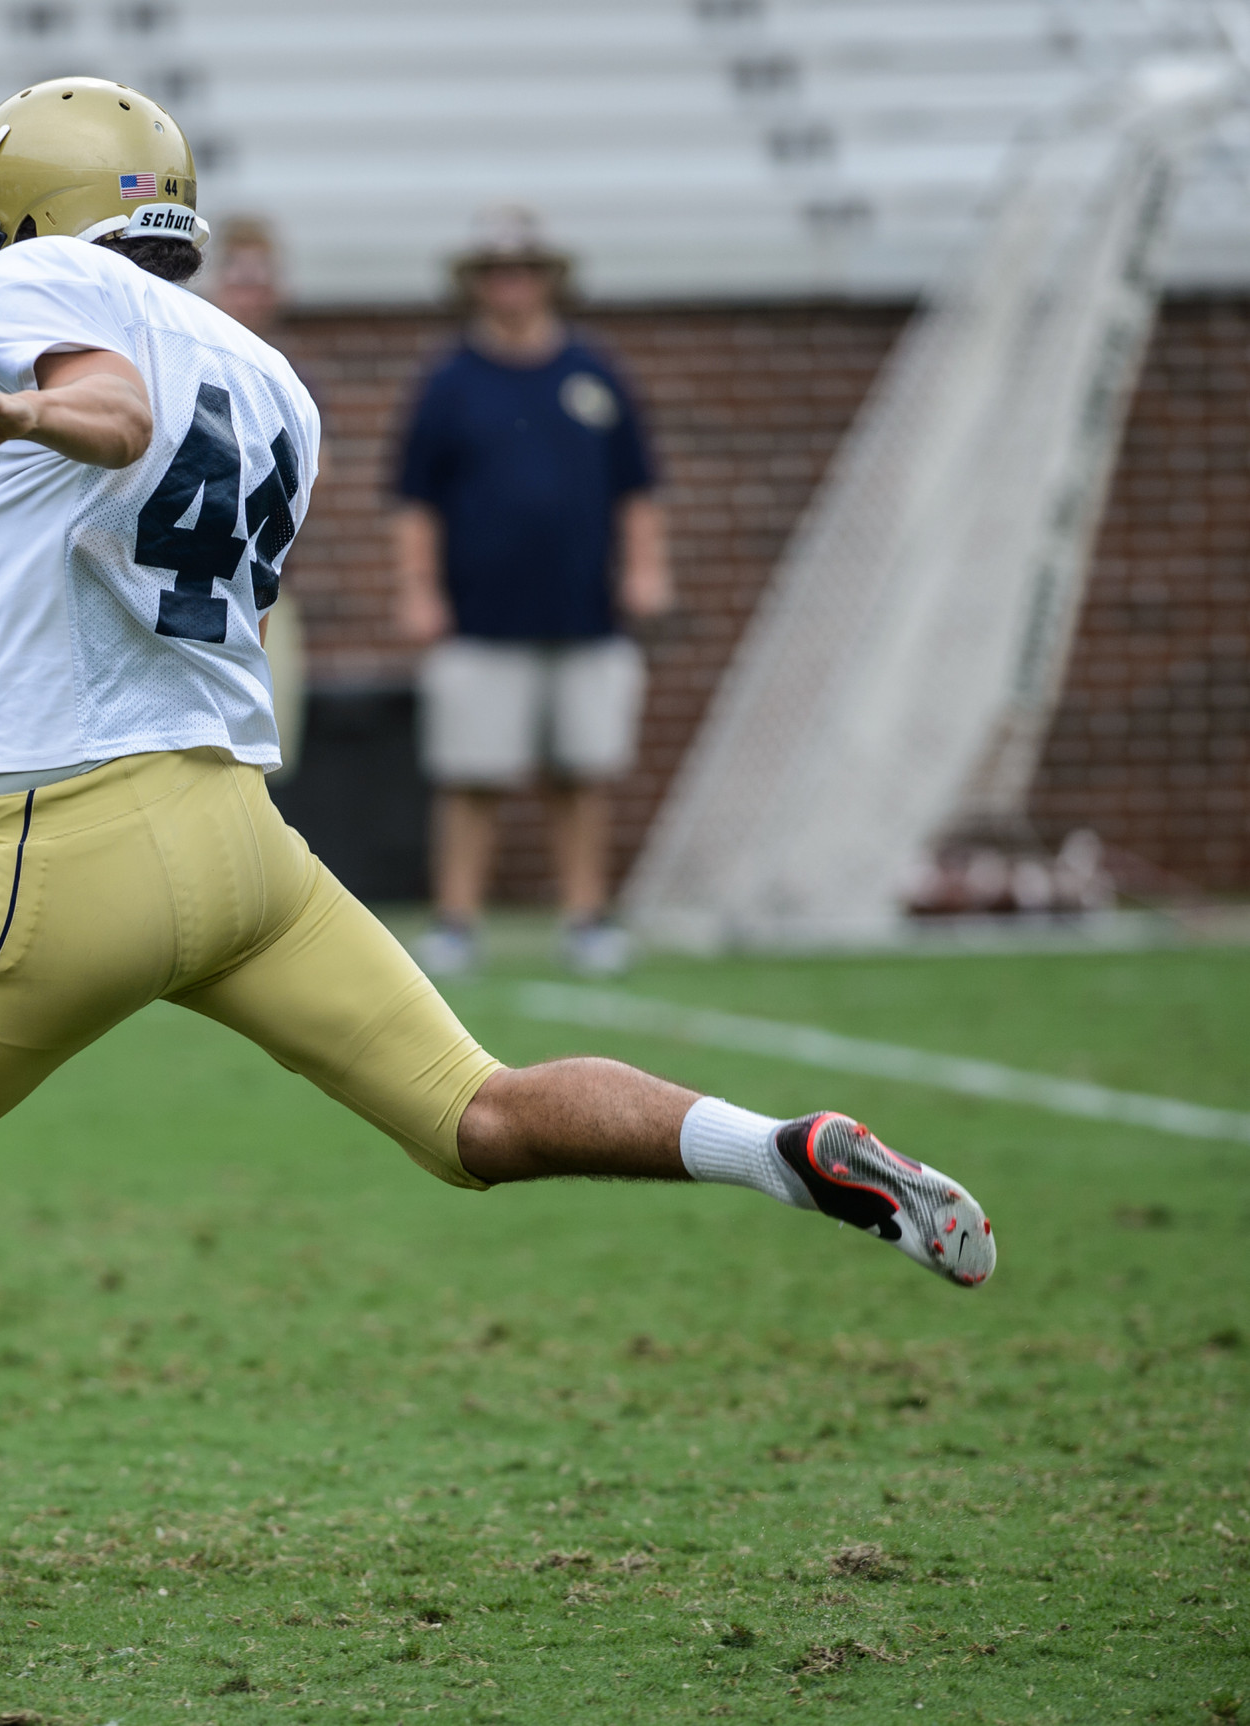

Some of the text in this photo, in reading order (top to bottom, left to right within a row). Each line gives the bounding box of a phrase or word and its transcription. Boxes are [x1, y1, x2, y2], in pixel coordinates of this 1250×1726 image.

[165, 178, 177, 196] 44
[140, 208, 195, 231] schutt
[134, 382, 299, 644] 44
